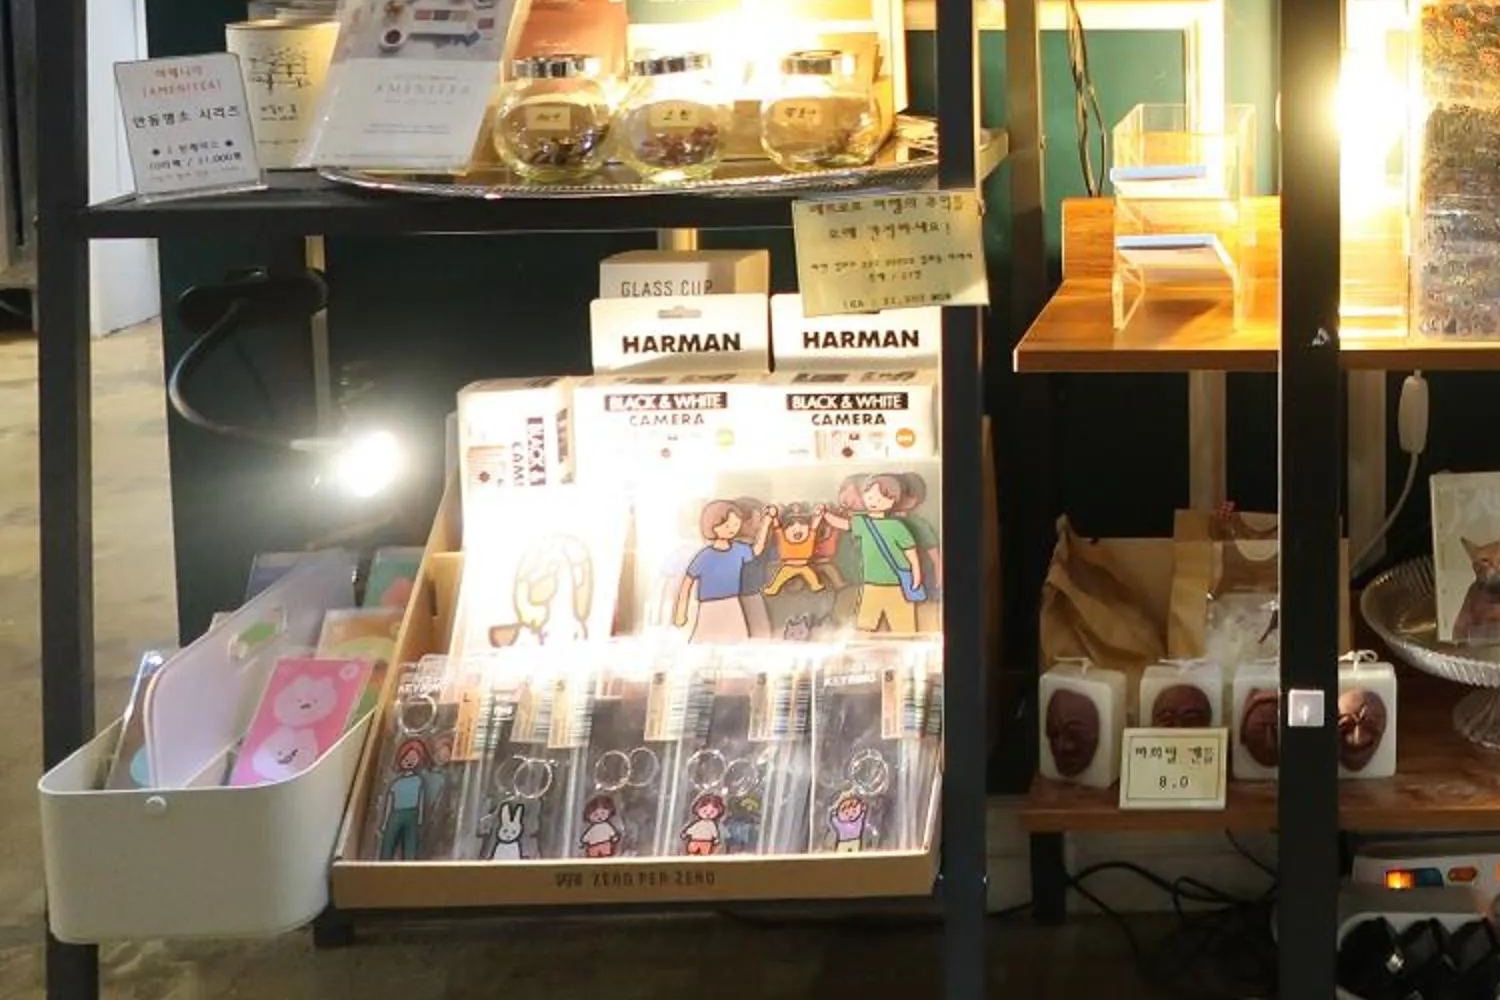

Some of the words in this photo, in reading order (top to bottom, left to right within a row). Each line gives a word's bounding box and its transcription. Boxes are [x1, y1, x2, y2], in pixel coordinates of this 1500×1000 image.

[621, 280, 674, 298] GLASS
[681, 279, 713, 297] CUP
[622, 332, 742, 355] HARMAN
[803, 329, 919, 350] HARMAN
[608, 394, 658, 410] BLACK
[677, 393, 725, 409] WHITE
[791, 394, 840, 410] BLACK
[841, 394, 854, 410] &
[857, 393, 902, 409] WHITE
[629, 413, 706, 427] CAMERA
[811, 412, 887, 426] CAMERA
[1159, 775, 1190, 789] 8.0
